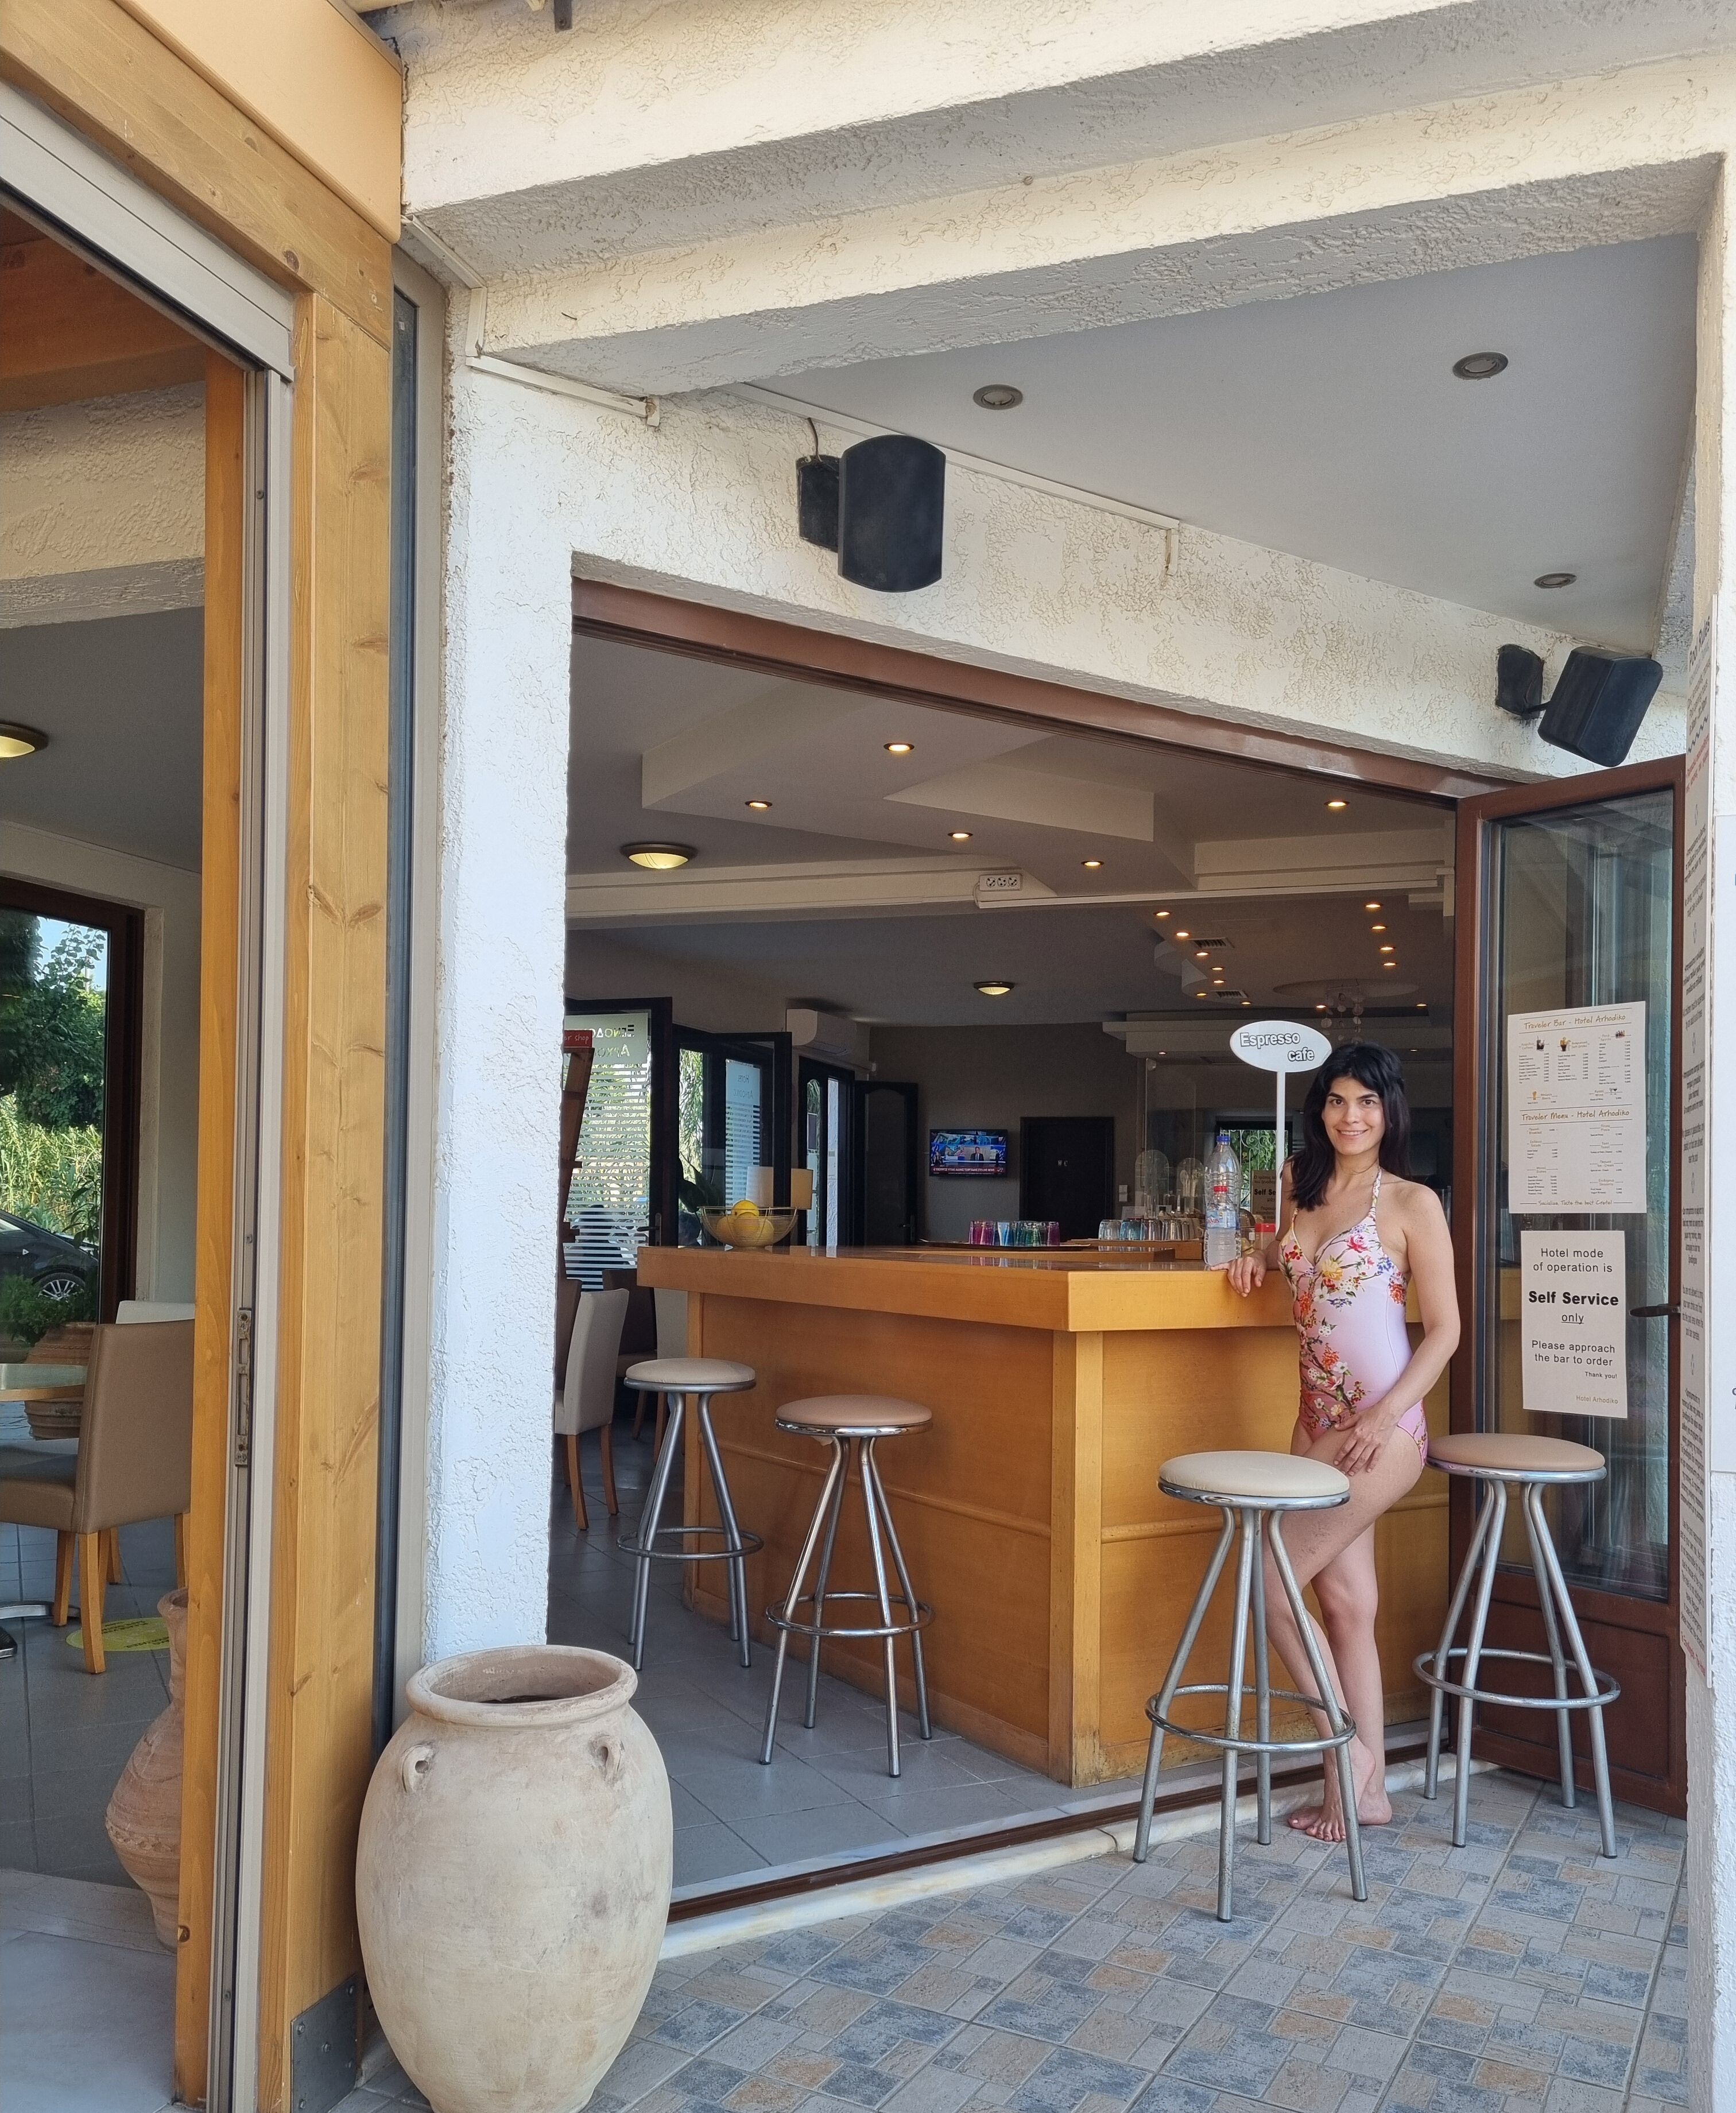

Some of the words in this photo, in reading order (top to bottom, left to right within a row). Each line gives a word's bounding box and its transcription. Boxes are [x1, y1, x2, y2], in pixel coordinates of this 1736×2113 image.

[1524, 1021, 1551, 1029] Traveler
[1575, 1016, 1593, 1024] Hotel
[1596, 1014, 1626, 1023] Arhodiko
[1239, 1032, 1301, 1049] Espresso
[1287, 1046, 1315, 1062] cafe
[1577, 1110, 1595, 1118] Hotel
[1598, 1108, 1630, 1118] Arhodiko
[1541, 1248, 1568, 1258] Hotel
[1573, 1248, 1603, 1258] mode
[1533, 1262, 1543, 1271] of
[1547, 1263, 1599, 1274] operation
[1603, 1263, 1613, 1273] is
[1528, 1291, 1556, 1304] Self
[1562, 1292, 1619, 1306] Service
[1561, 1313, 1584, 1324] only
[1532, 1340, 1565, 1350] Please
[1569, 1344, 1615, 1354] approach
[1534, 1353, 1549, 1362] the
[1554, 1354, 1570, 1363] bar
[1573, 1355, 1582, 1364] to
[1586, 1358, 1613, 1366] order
